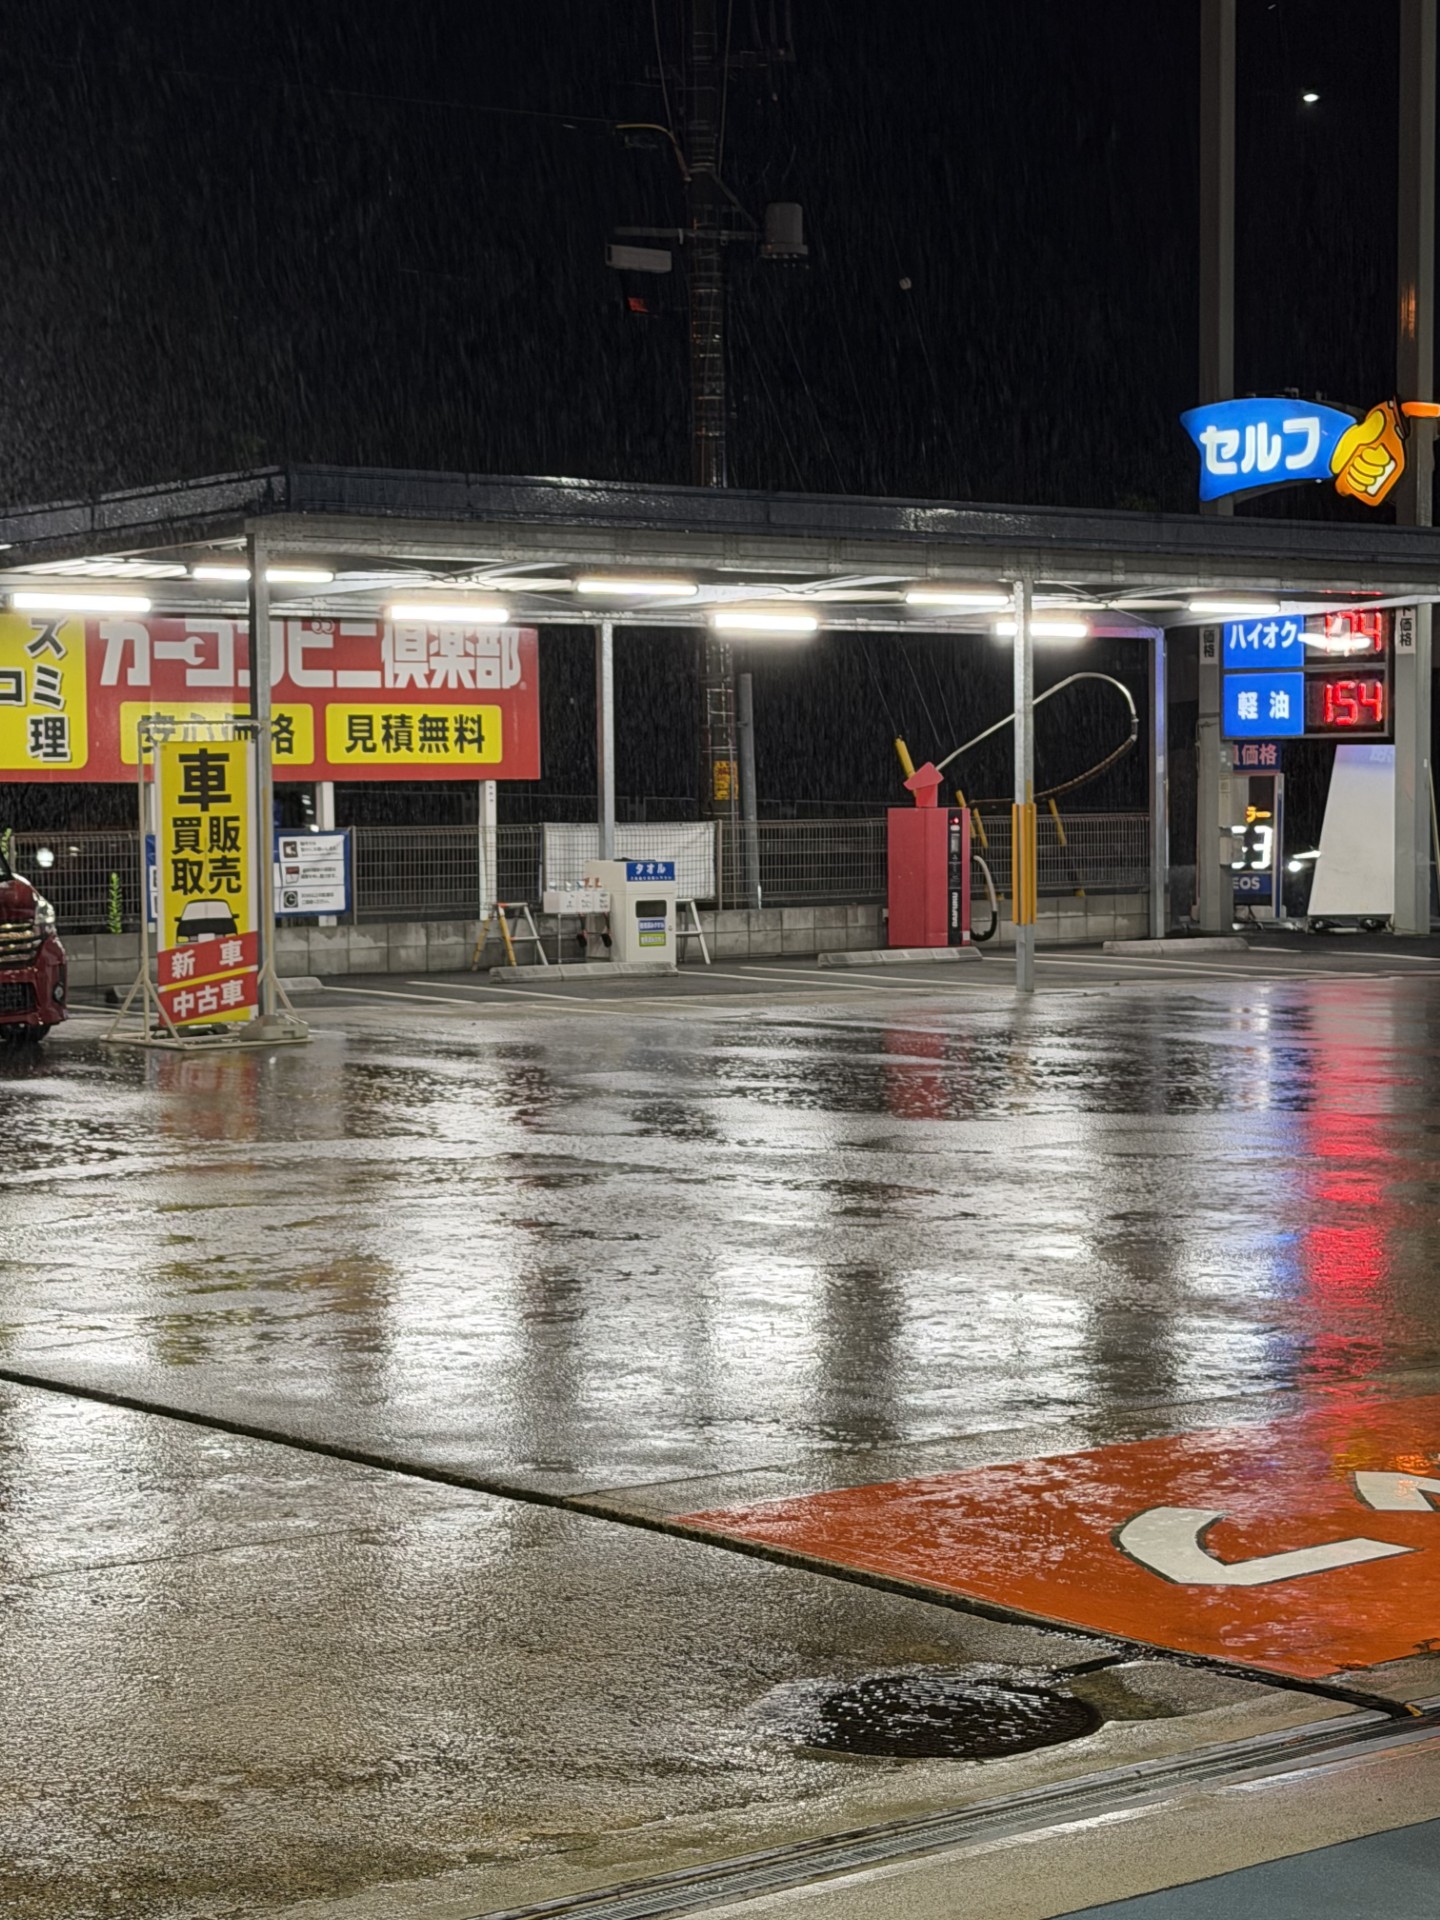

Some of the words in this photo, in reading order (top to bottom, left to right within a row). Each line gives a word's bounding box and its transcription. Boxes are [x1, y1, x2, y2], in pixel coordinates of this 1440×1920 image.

[1199, 417, 1320, 475] セルフ
[1229, 621, 1298, 650] ハイオク
[1237, 691, 1290, 720] 軽油
[1323, 681, 1383, 726] 154
[345, 713, 485, 754] 見積無料
[178, 748, 232, 812] 車
[635, 863, 666, 875] タオル
[173, 980, 244, 1018] 中古車
